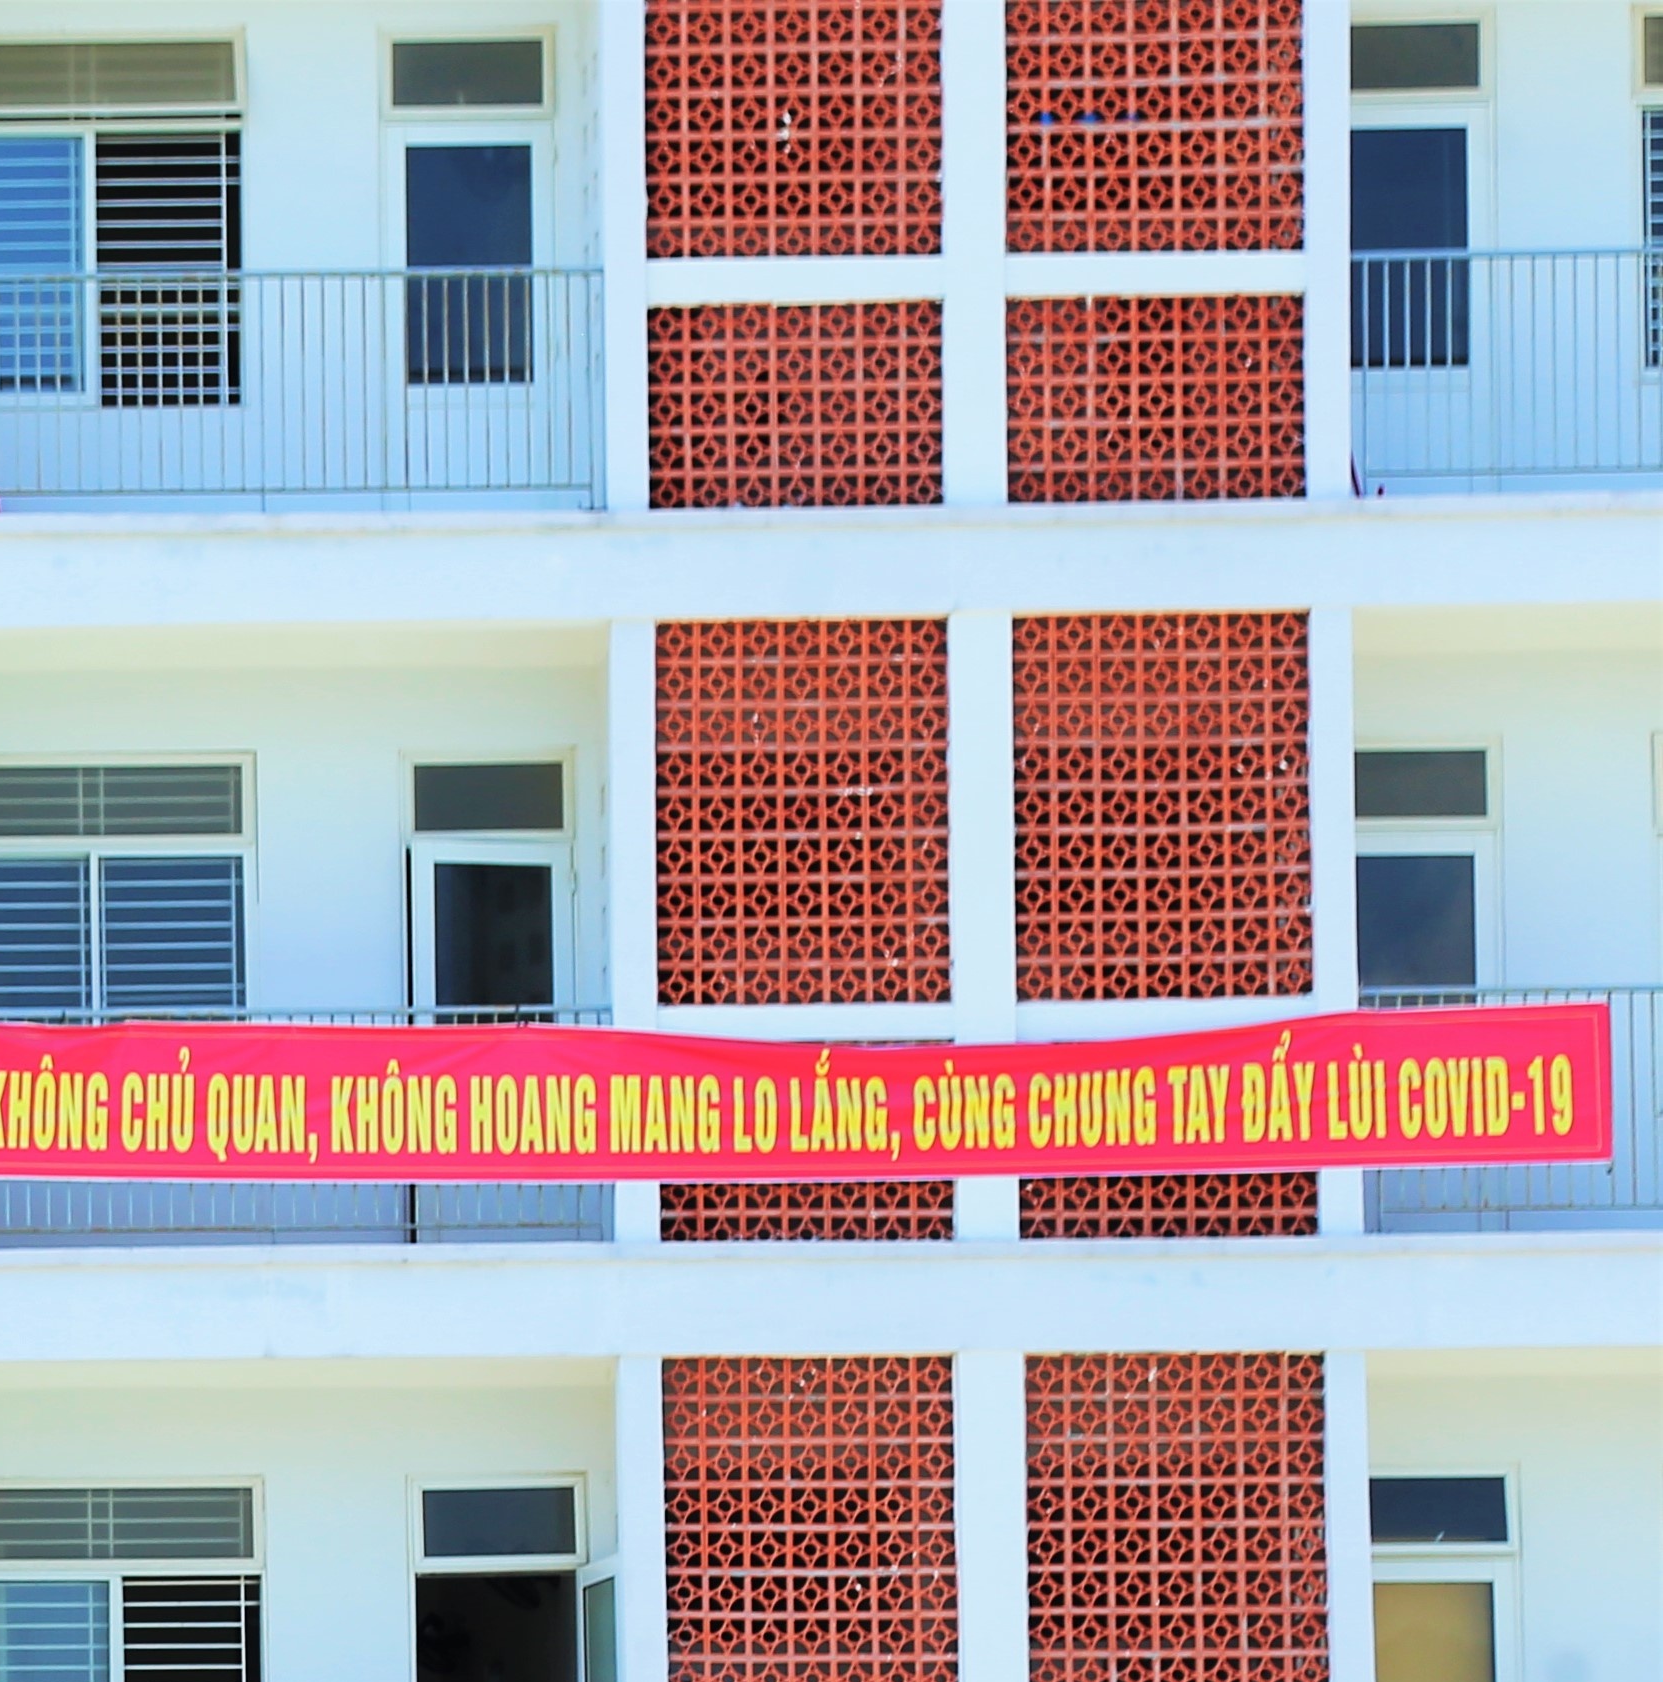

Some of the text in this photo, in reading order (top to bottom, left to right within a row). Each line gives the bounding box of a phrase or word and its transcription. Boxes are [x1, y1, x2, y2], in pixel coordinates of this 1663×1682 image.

[120, 1047, 195, 1154] CHỦ
[206, 1072, 318, 1164] QUAN,
[330, 1058, 458, 1155] KHÔNG
[470, 1074, 597, 1155] HOANG
[610, 1074, 721, 1154] MANG
[733, 1076, 778, 1154] LO
[789, 1048, 902, 1162] LẮNG,
[913, 1060, 1016, 1151] CÙNG
[1027, 1066, 1157, 1149] CHUNG
[1167, 1064, 1230, 1145] TAY
[1241, 1030, 1315, 1143] ĐẨY
[1327, 1043, 1387, 1141] LÙI
[1398, 1053, 1573, 1140] COVID-19
